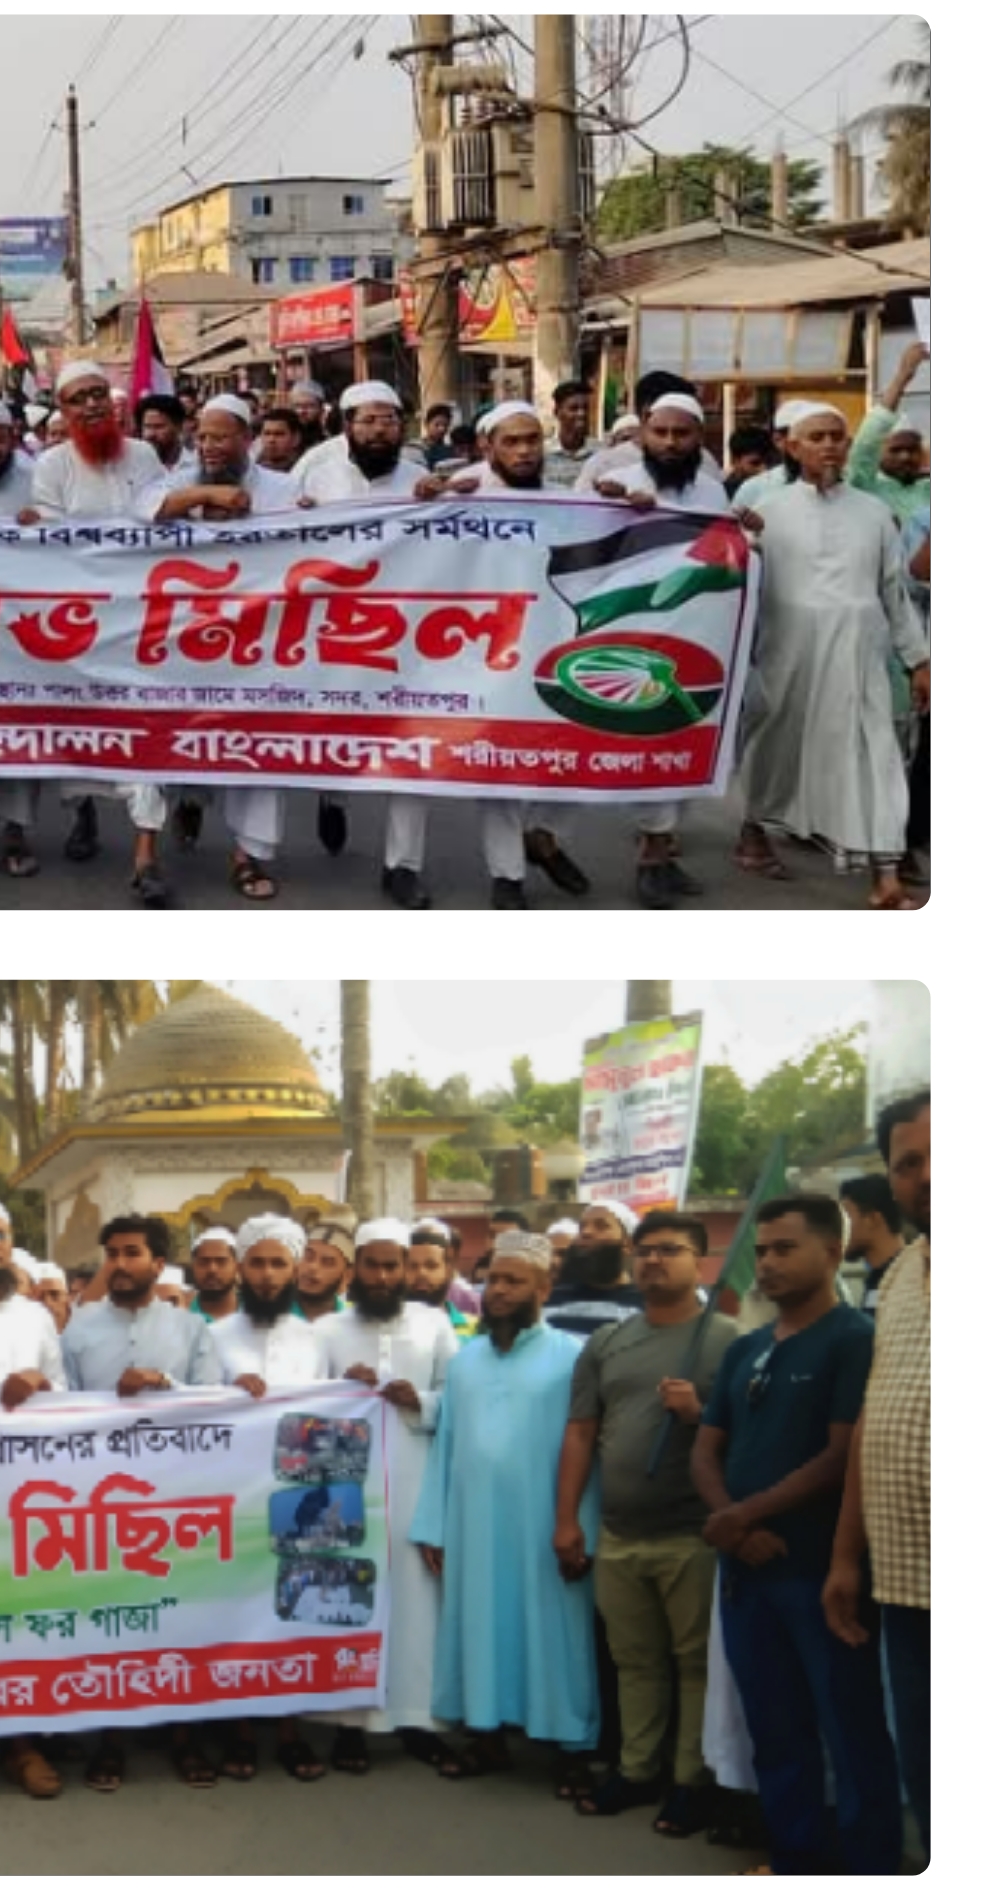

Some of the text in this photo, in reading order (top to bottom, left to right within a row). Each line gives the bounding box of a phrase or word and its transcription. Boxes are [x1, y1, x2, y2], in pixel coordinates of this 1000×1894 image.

[136, 557, 539, 673] মিছিল
[172, 722, 445, 771] বাংলাদেশ
[588, 750, 644, 774] জেলা
[106, 1416, 236, 1456] প্রতিবাদে
[8, 1472, 236, 1578] মিছিল
[23, 1609, 78, 1642] ফর
[50, 1658, 197, 1704] তৌহিদী
[206, 1652, 319, 1691] জনতা
